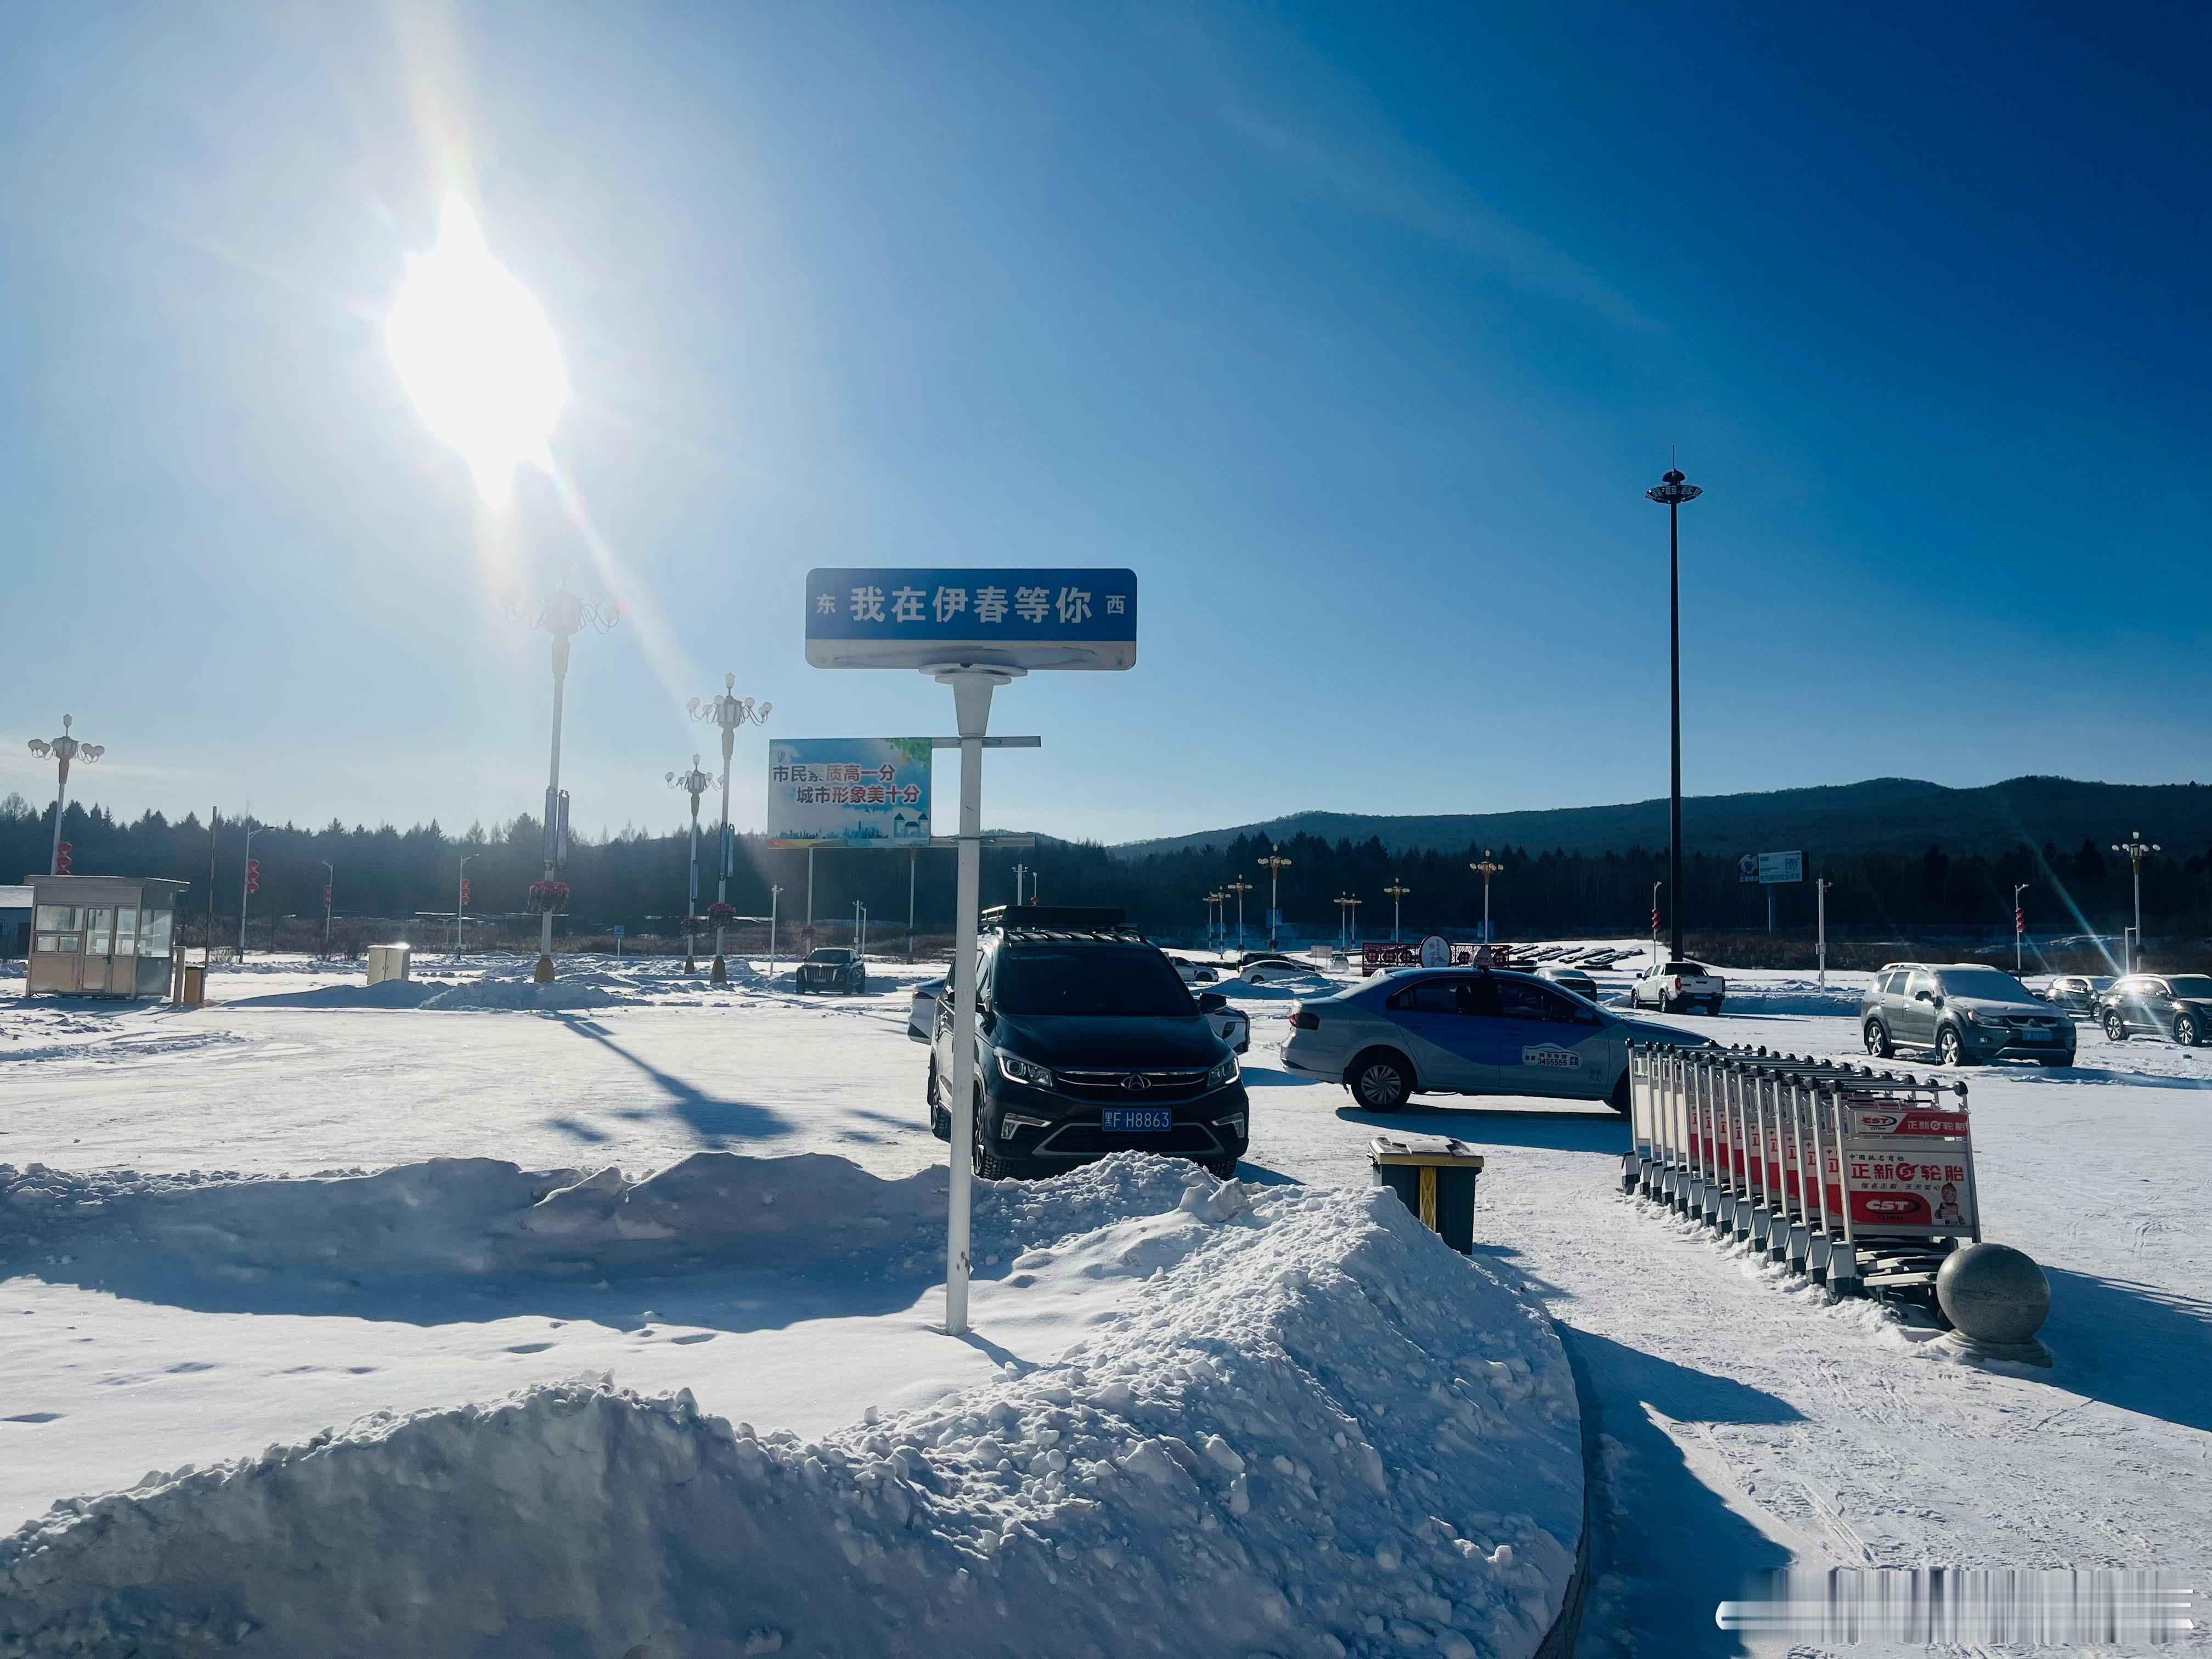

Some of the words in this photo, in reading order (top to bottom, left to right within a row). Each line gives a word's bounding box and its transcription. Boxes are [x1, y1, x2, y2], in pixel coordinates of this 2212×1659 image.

[816, 594, 836, 614] 东
[850, 586, 1092, 623] 我在伊春等你
[1106, 595, 1126, 614] 西
[797, 785, 919, 804] 城市形象美十分
[1537, 1058, 1567, 1066] 3455555
[1849, 1154, 1905, 1162] 中国驰名商标
[1866, 1200, 1909, 1210] CST
